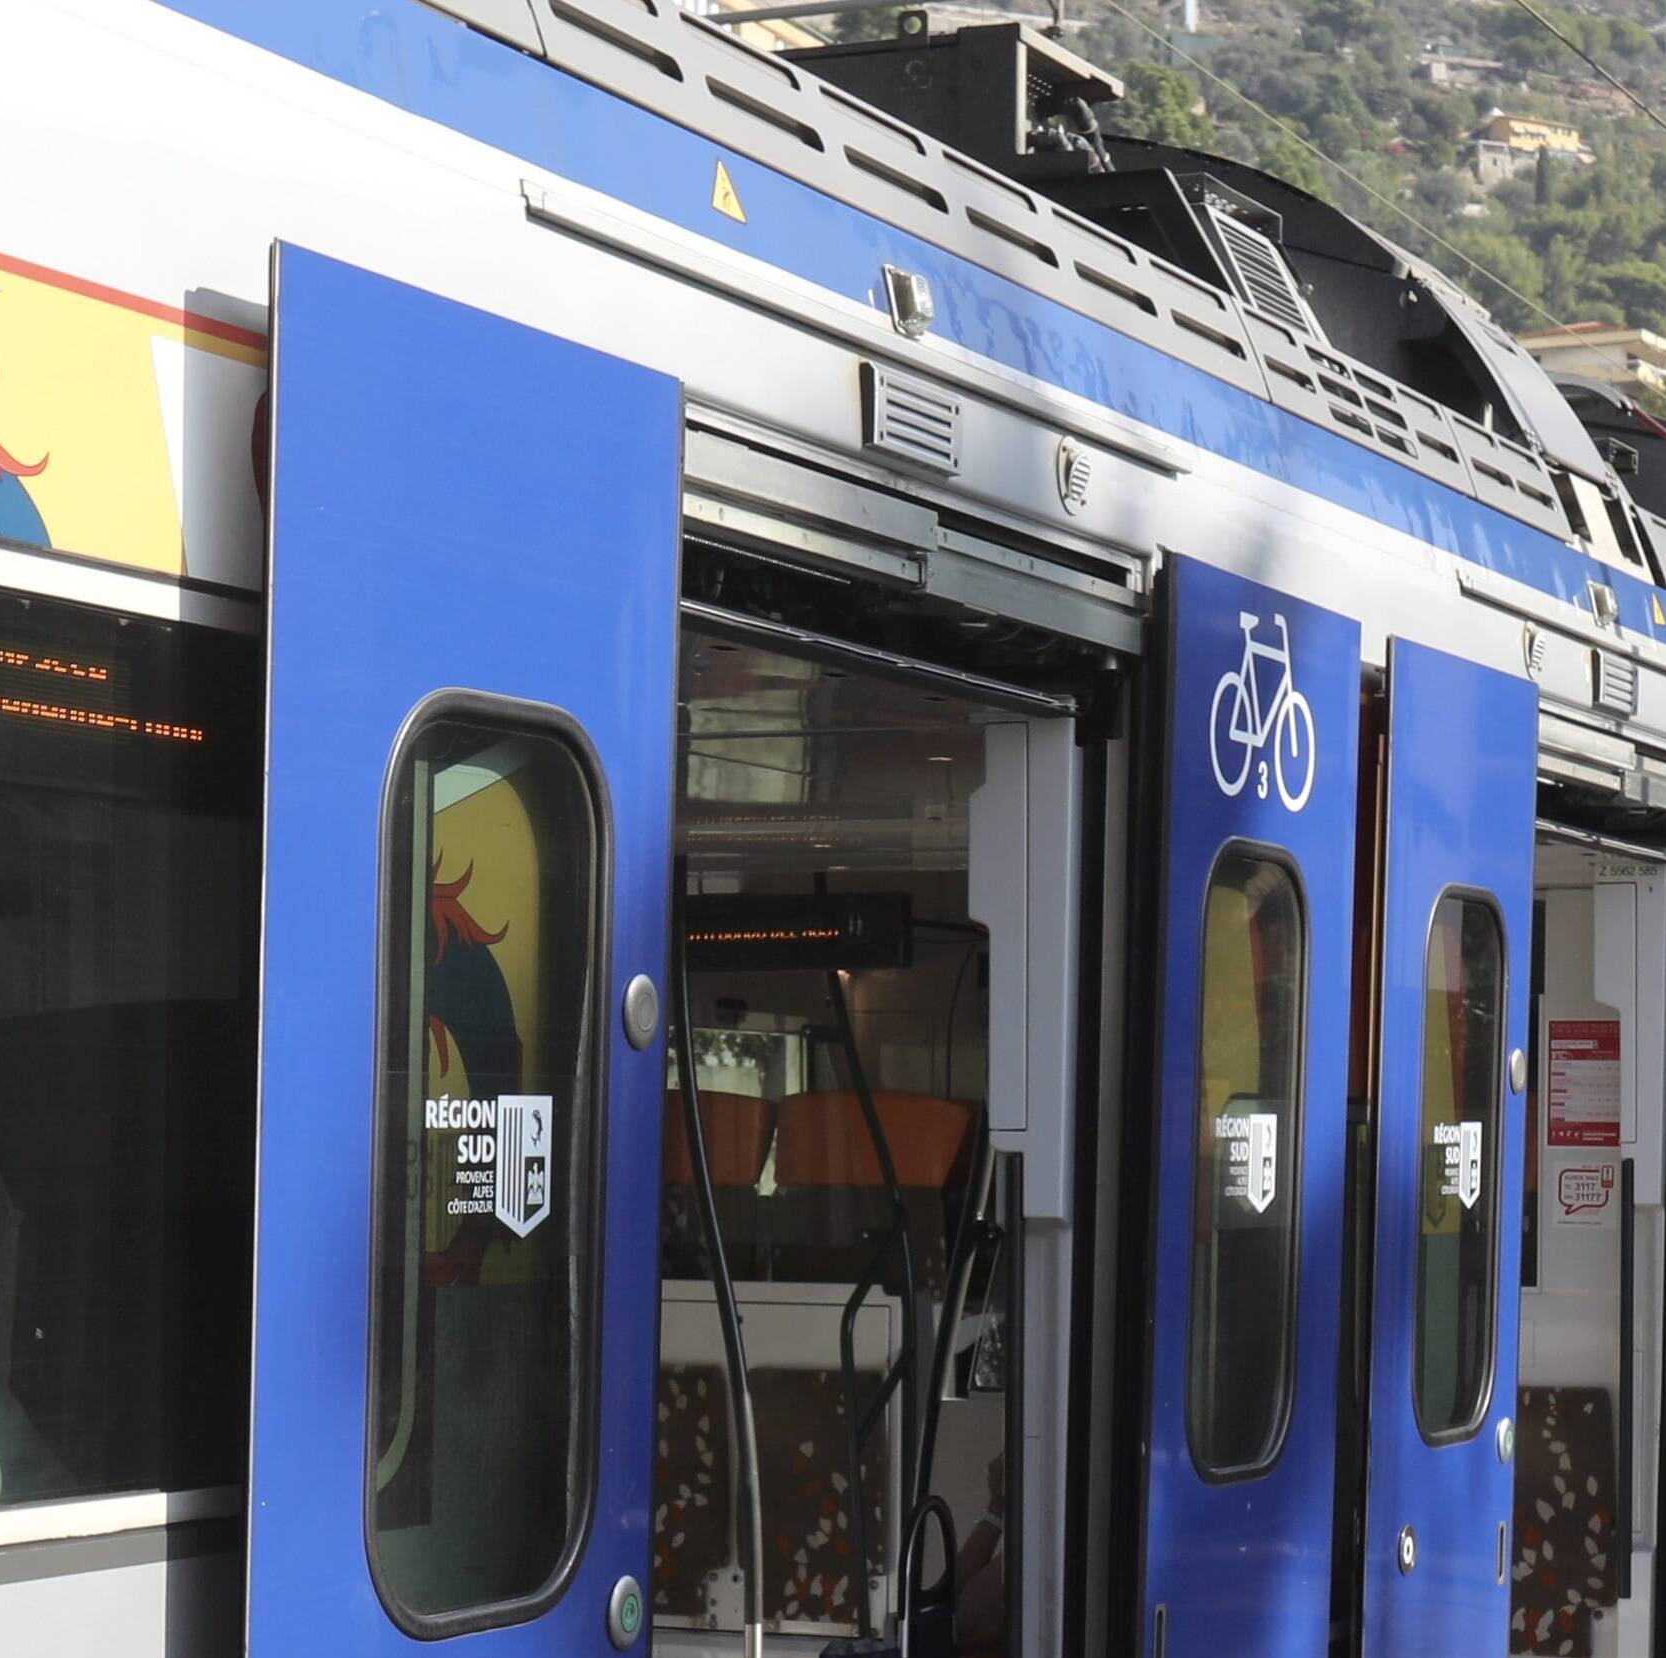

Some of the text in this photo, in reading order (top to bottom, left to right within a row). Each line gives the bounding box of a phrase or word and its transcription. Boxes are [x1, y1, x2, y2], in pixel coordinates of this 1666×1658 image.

[1257, 760, 1268, 799] 3
[1599, 865, 1607, 877] Z
[425, 1094, 496, 1128] RÉGION
[1215, 1114, 1250, 1138] RÉGION
[457, 1134, 495, 1164] SUD
[1230, 1141, 1249, 1162] SUD
[1445, 1146, 1459, 1165] SUD
[456, 1170, 494, 1184] PROVENCE
[1575, 1182, 1596, 1191] 3117
[472, 1185, 494, 1198] ALPES
